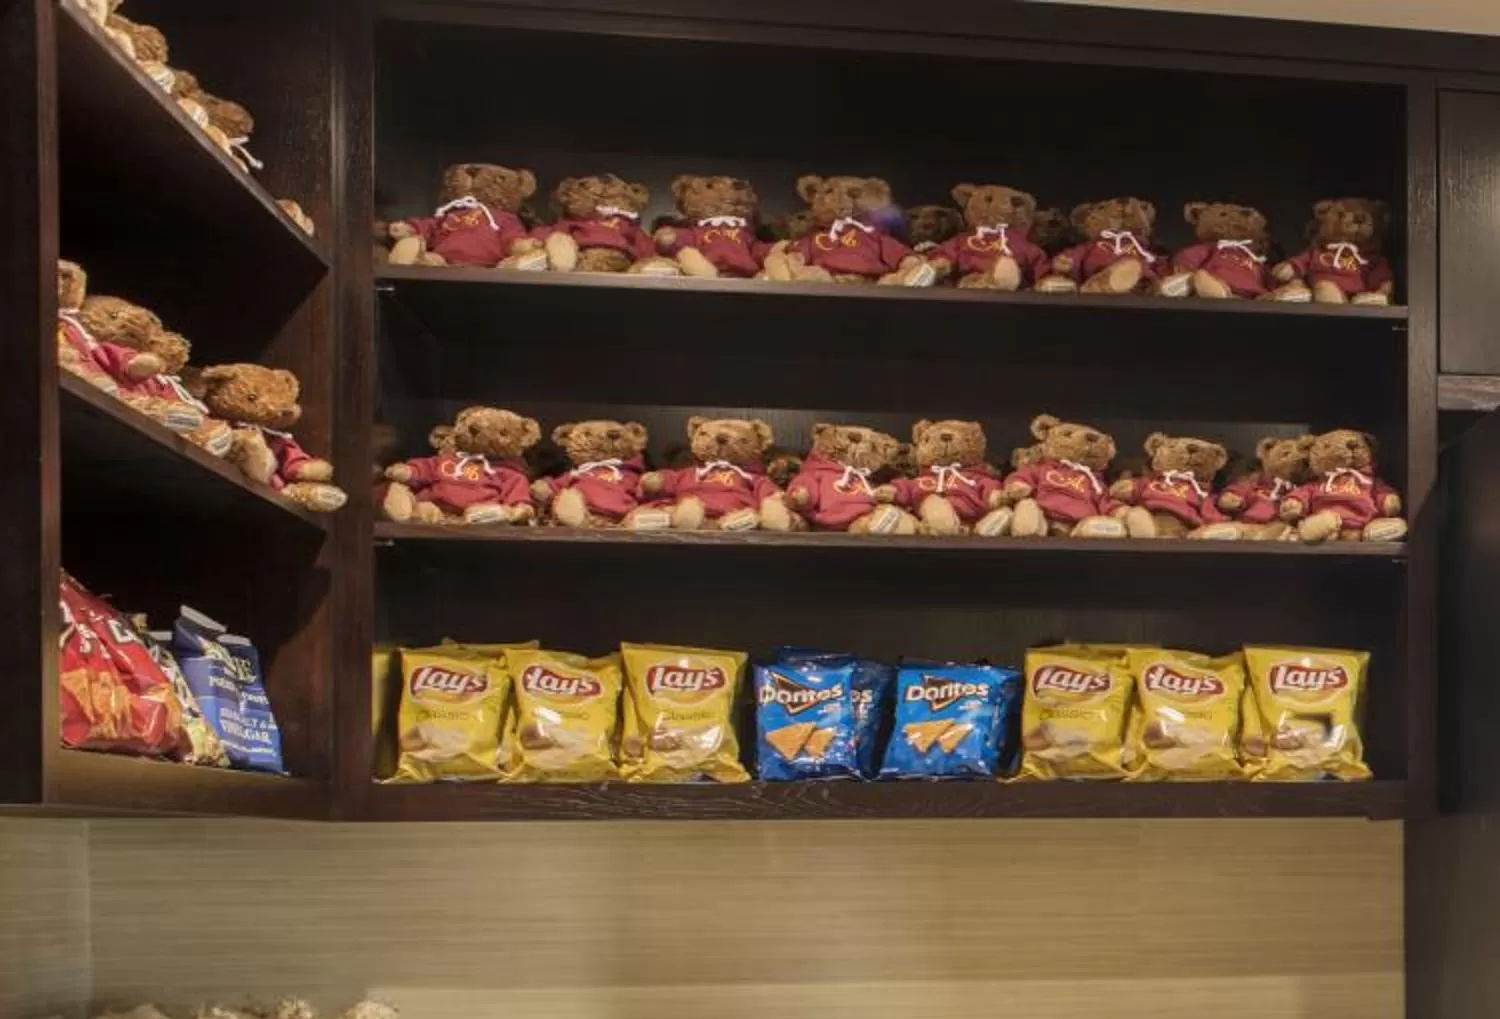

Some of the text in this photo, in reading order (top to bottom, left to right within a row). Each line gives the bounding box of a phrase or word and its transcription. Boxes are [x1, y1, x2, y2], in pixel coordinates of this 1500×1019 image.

[414, 666, 488, 693] Lay's
[525, 667, 601, 695] Lay's
[650, 666, 722, 690] Lay's
[1037, 665, 1111, 692] Lay's
[1146, 666, 1225, 694] Lay's
[1273, 665, 1348, 690] Lay's
[905, 682, 990, 704] Doritos
